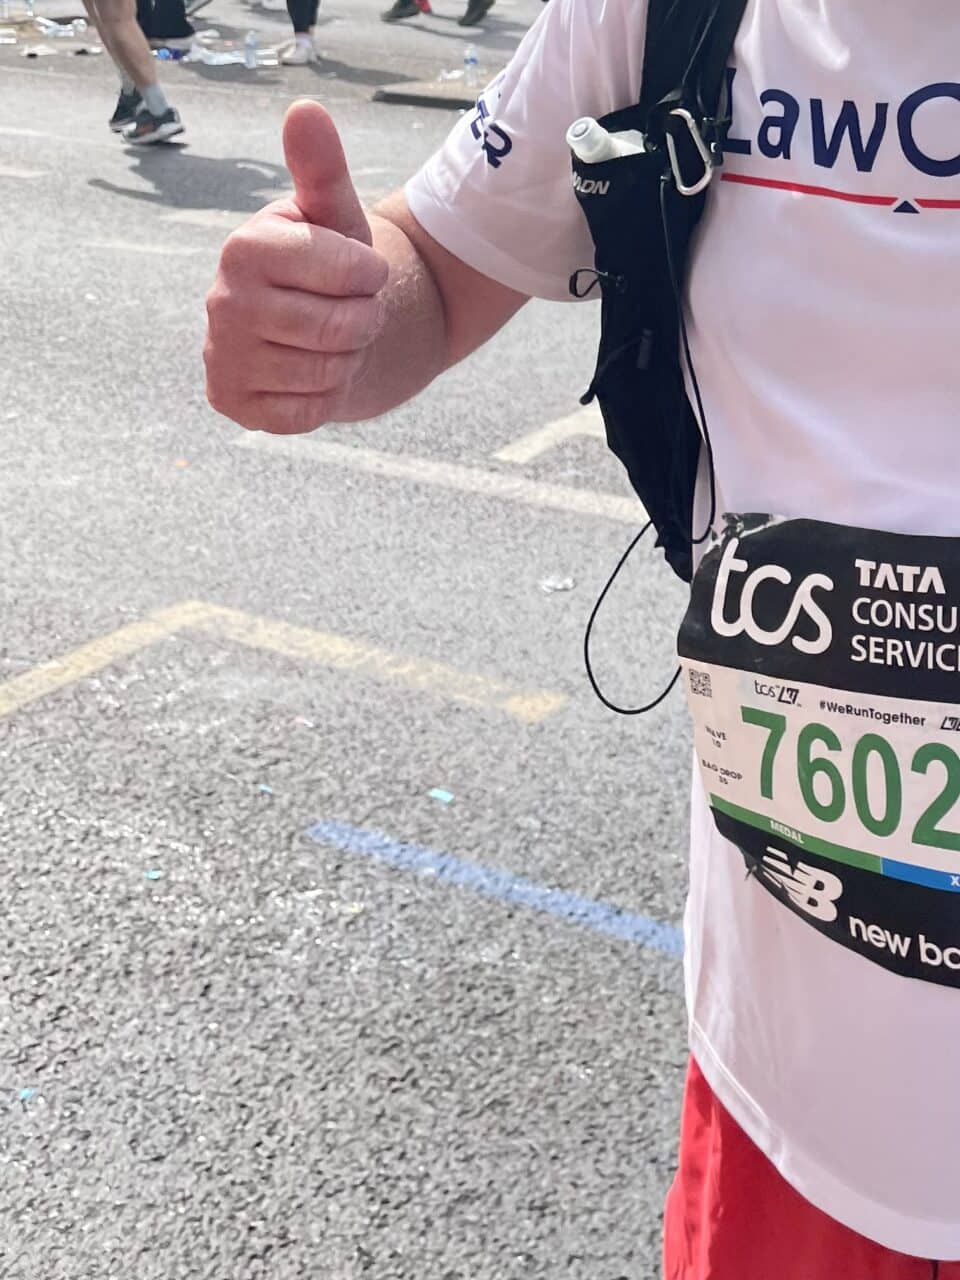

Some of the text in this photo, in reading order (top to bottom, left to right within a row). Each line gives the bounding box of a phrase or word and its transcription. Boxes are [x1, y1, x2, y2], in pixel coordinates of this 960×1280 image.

[855, 558, 946, 594] TATA
[711, 537, 834, 654] tcs
[819, 700, 926, 727] #WeRunTogether
[705, 725, 727, 741] WAVE
[702, 759, 743, 781] BAG DROP
[770, 819, 805, 845] MEDAL
[848, 915, 911, 959] new
